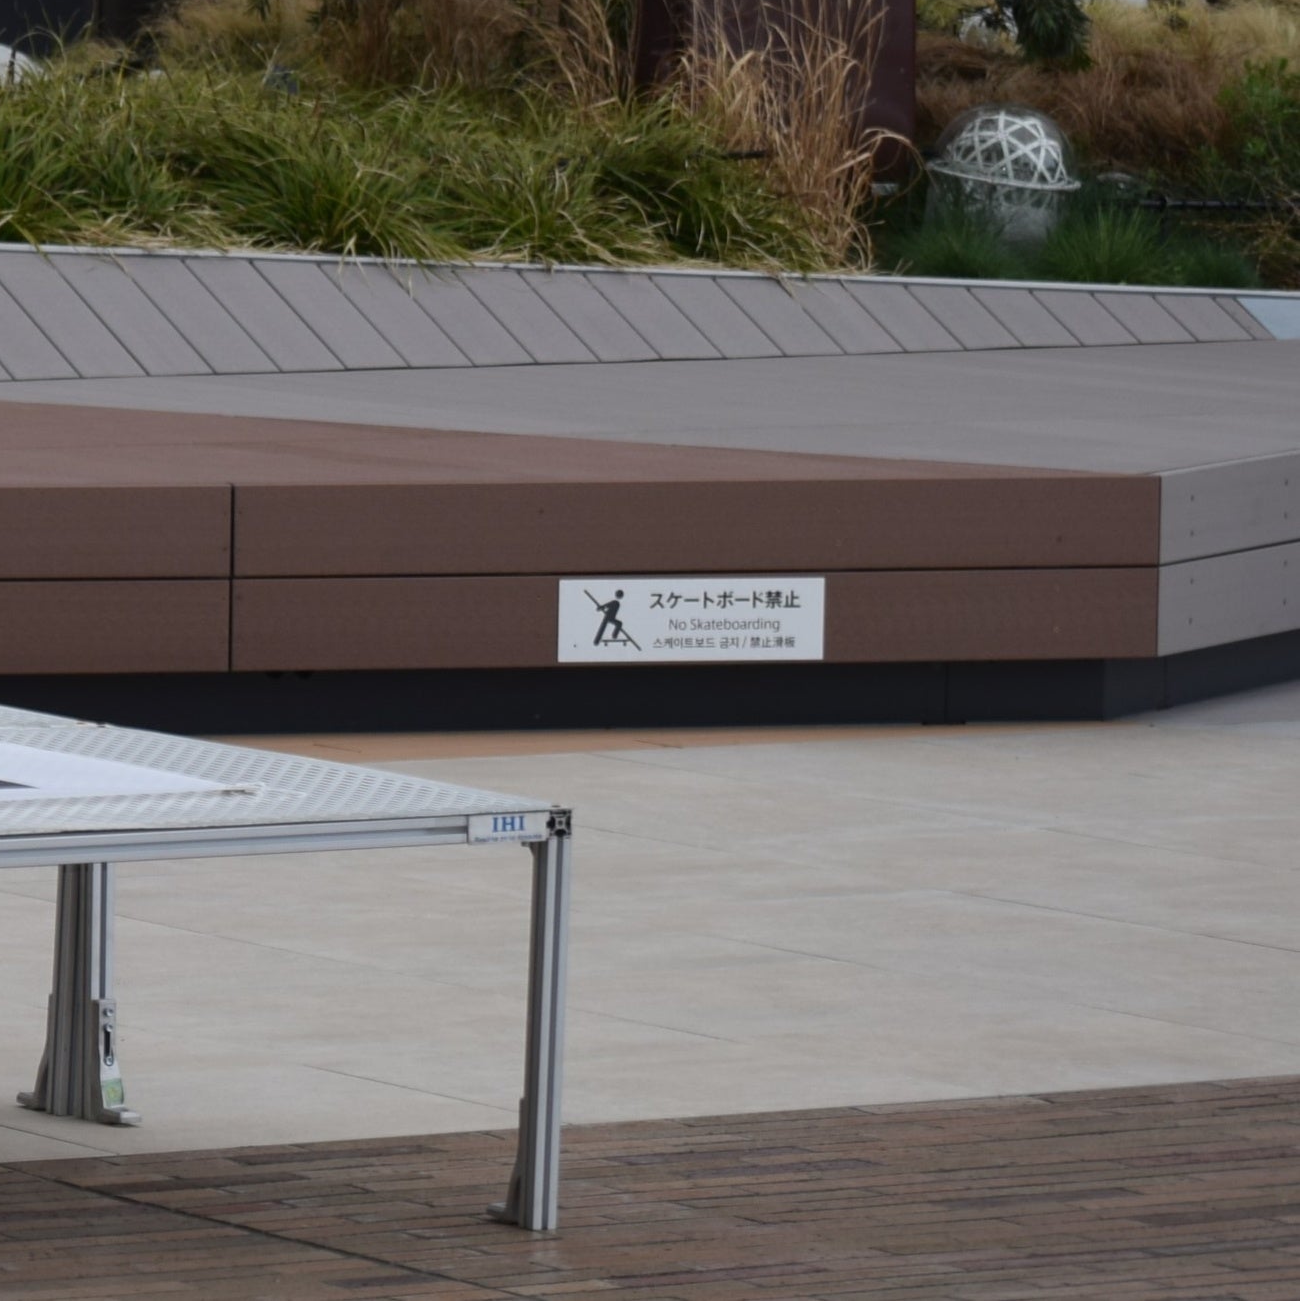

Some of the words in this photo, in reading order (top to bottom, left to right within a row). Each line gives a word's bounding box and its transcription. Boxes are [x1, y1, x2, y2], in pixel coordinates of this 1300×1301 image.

[649, 590, 801, 609] スケートボード禁止
[668, 618, 688, 631] No
[690, 617, 781, 633] Skateboarding
[652, 636, 715, 649] 스케이트보드
[719, 636, 739, 649] 금지
[492, 816, 526, 833] IHI
